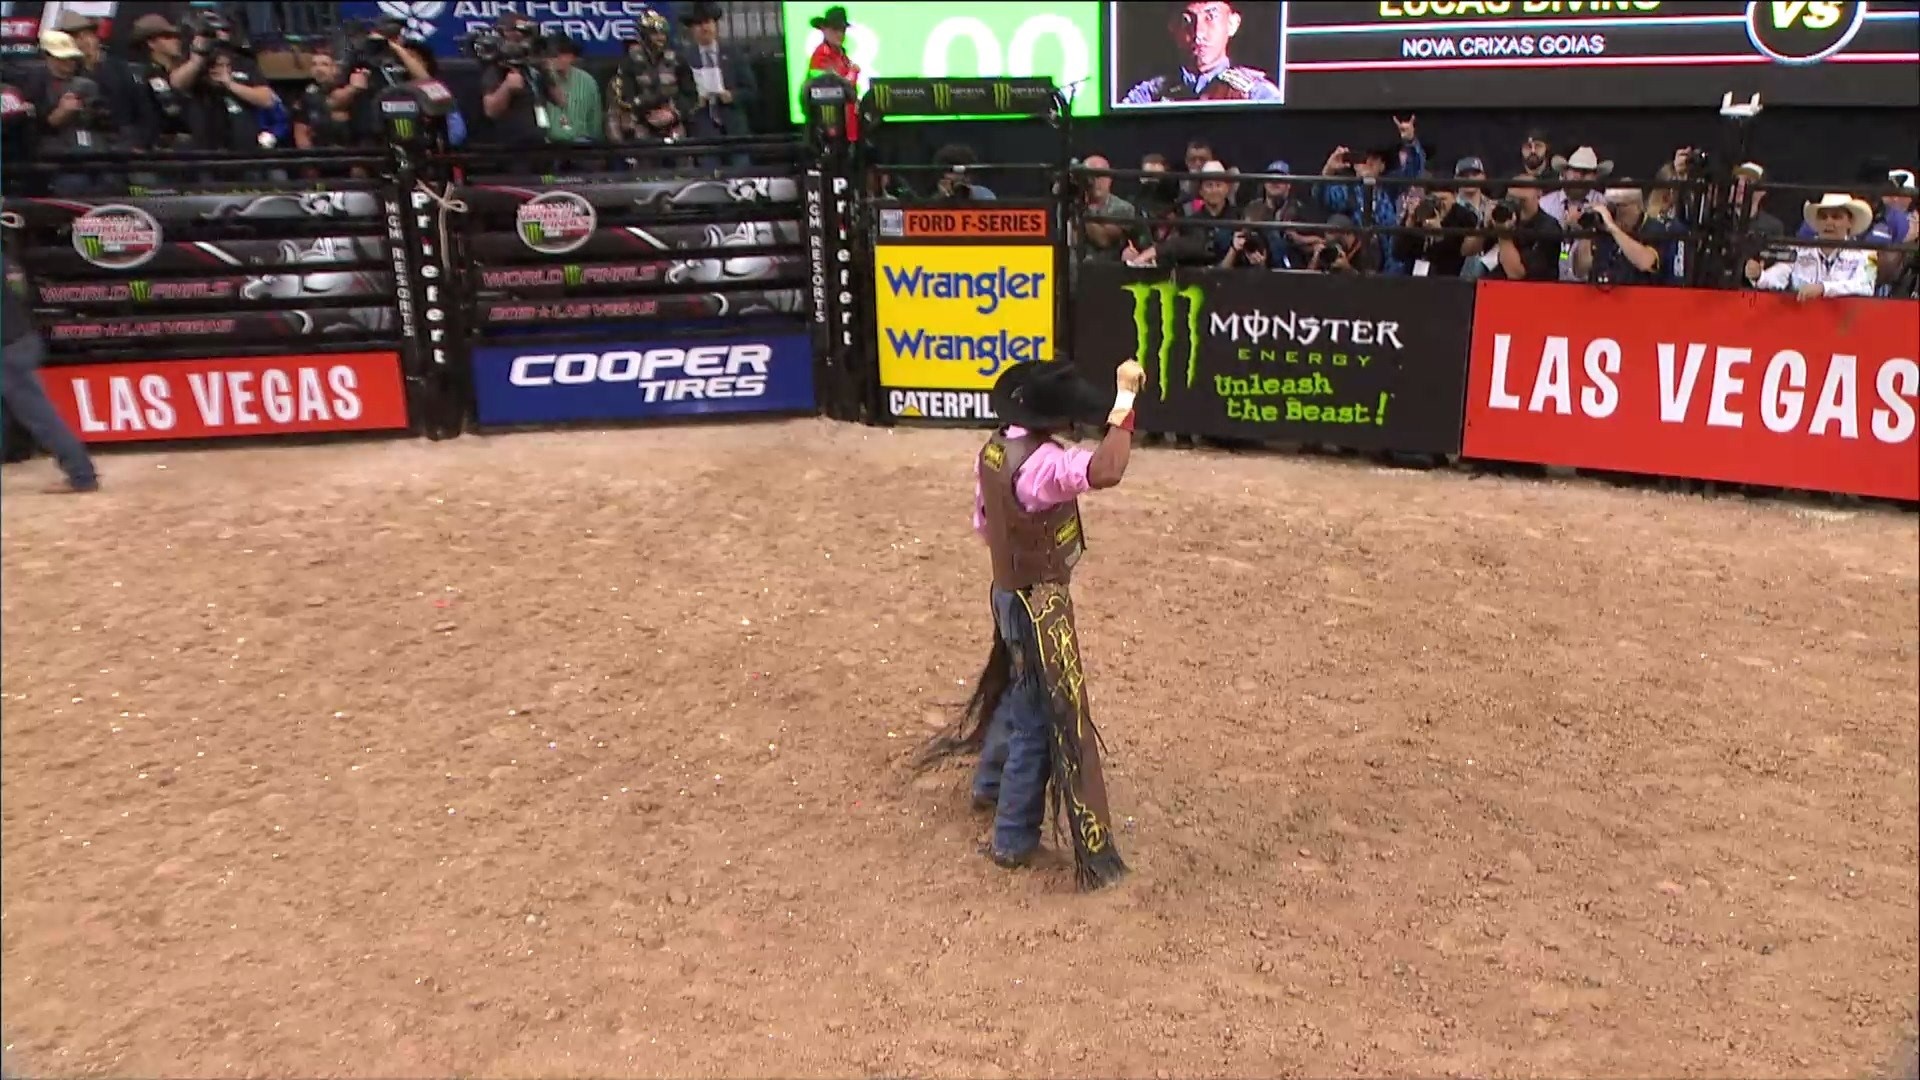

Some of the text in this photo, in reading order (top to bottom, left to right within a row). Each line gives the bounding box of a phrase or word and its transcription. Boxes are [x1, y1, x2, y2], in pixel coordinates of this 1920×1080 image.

[525, 1, 645, 18] FORCE
[1402, 34, 1605, 57] NOVA CRIXAS GOIAS
[908, 214, 956, 232] FORD
[961, 214, 1041, 232] F-SERIES
[411, 191, 446, 364] Priefert
[807, 191, 825, 323] MGM RESORTS
[832, 177, 852, 345] Priefert
[883, 265, 1046, 315] Wrangler
[1209, 309, 1403, 349] MONSTER
[509, 344, 772, 386] COOPER
[885, 328, 1046, 376] Wrangler
[1237, 348, 1372, 367] ENERGY
[71, 364, 363, 432] LAS VEGAS
[638, 374, 767, 403] TIRES
[1214, 372, 1333, 397] Unleash
[1488, 333, 1919, 443] LAS VEGAS
[1227, 398, 1278, 421] the
